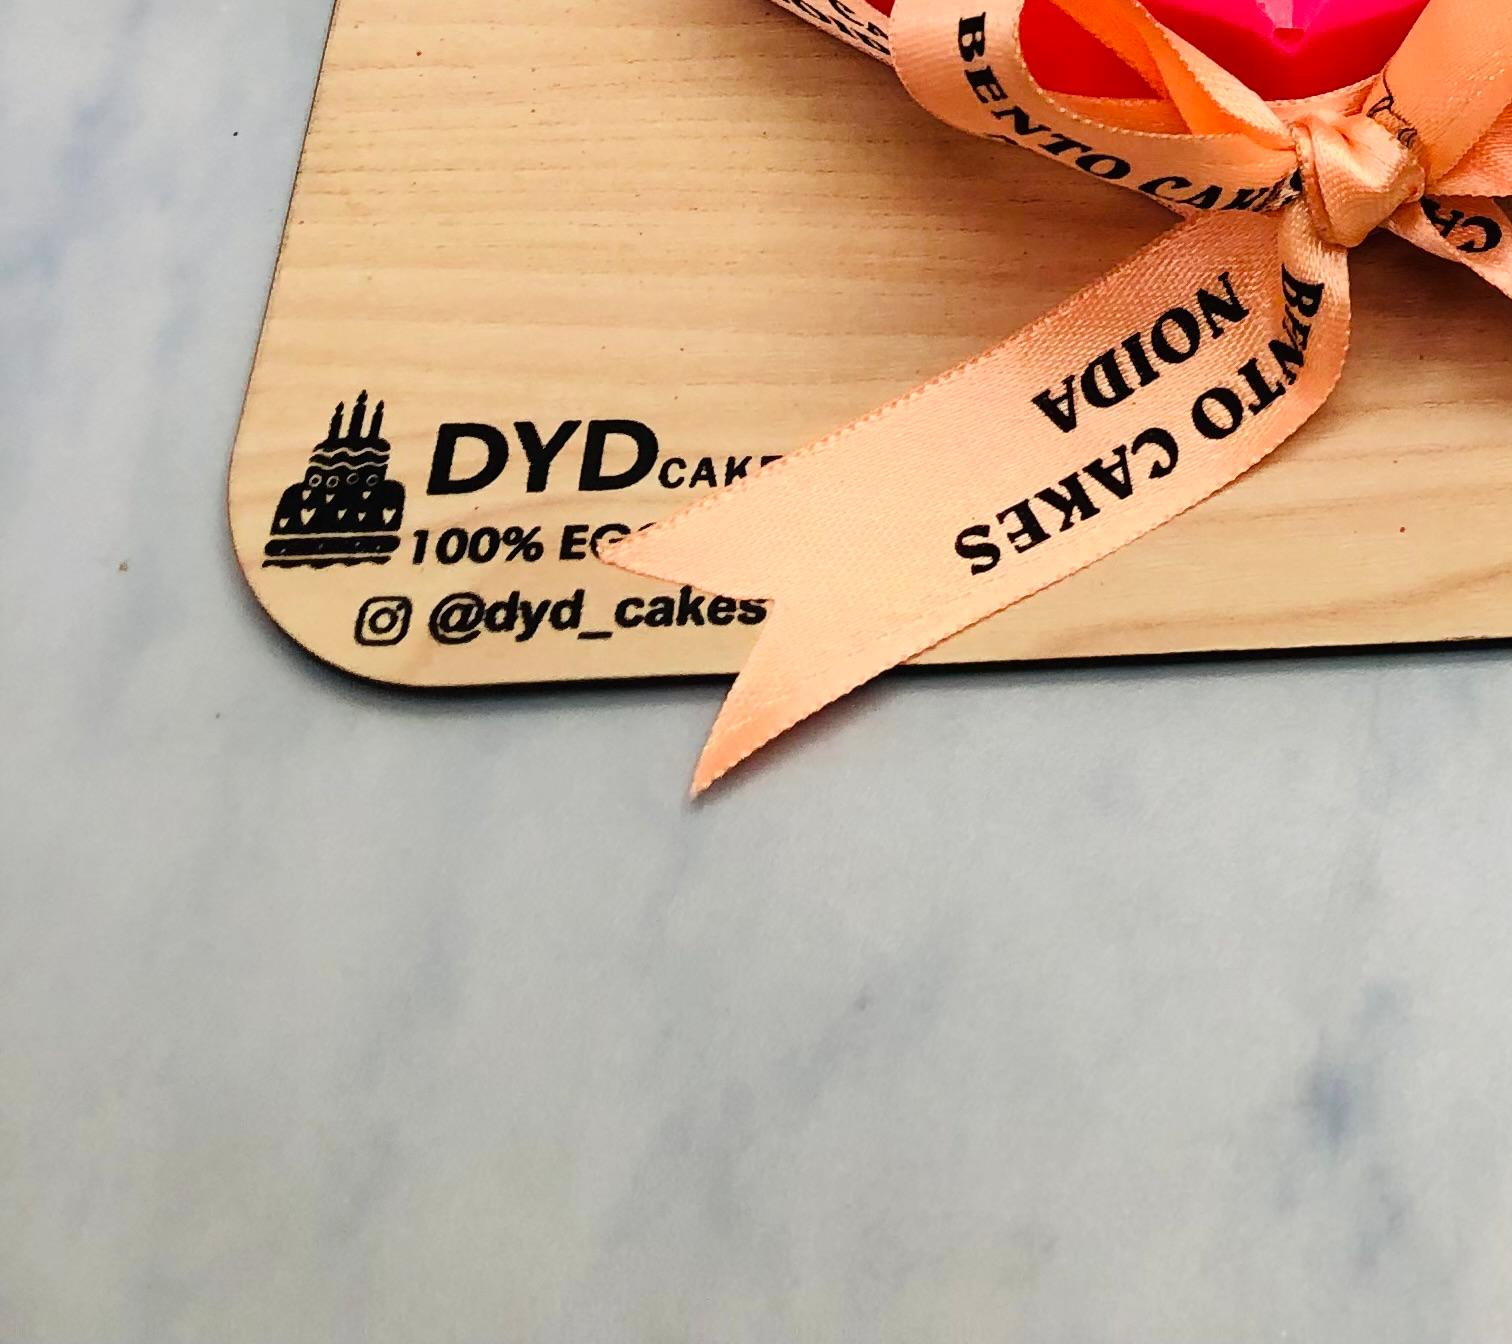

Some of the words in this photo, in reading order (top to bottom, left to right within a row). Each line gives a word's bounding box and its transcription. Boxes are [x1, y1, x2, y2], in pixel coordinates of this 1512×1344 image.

[958, 12, 1131, 180] BENTO
[1030, 272, 1250, 433] NOIDA
[426, 420, 660, 496] DYD
[658, 455, 783, 488] CAK
[954, 427, 1178, 575] CAKES
[411, 525, 543, 565] 100%
[428, 584, 768, 645] @dyd_cakes
